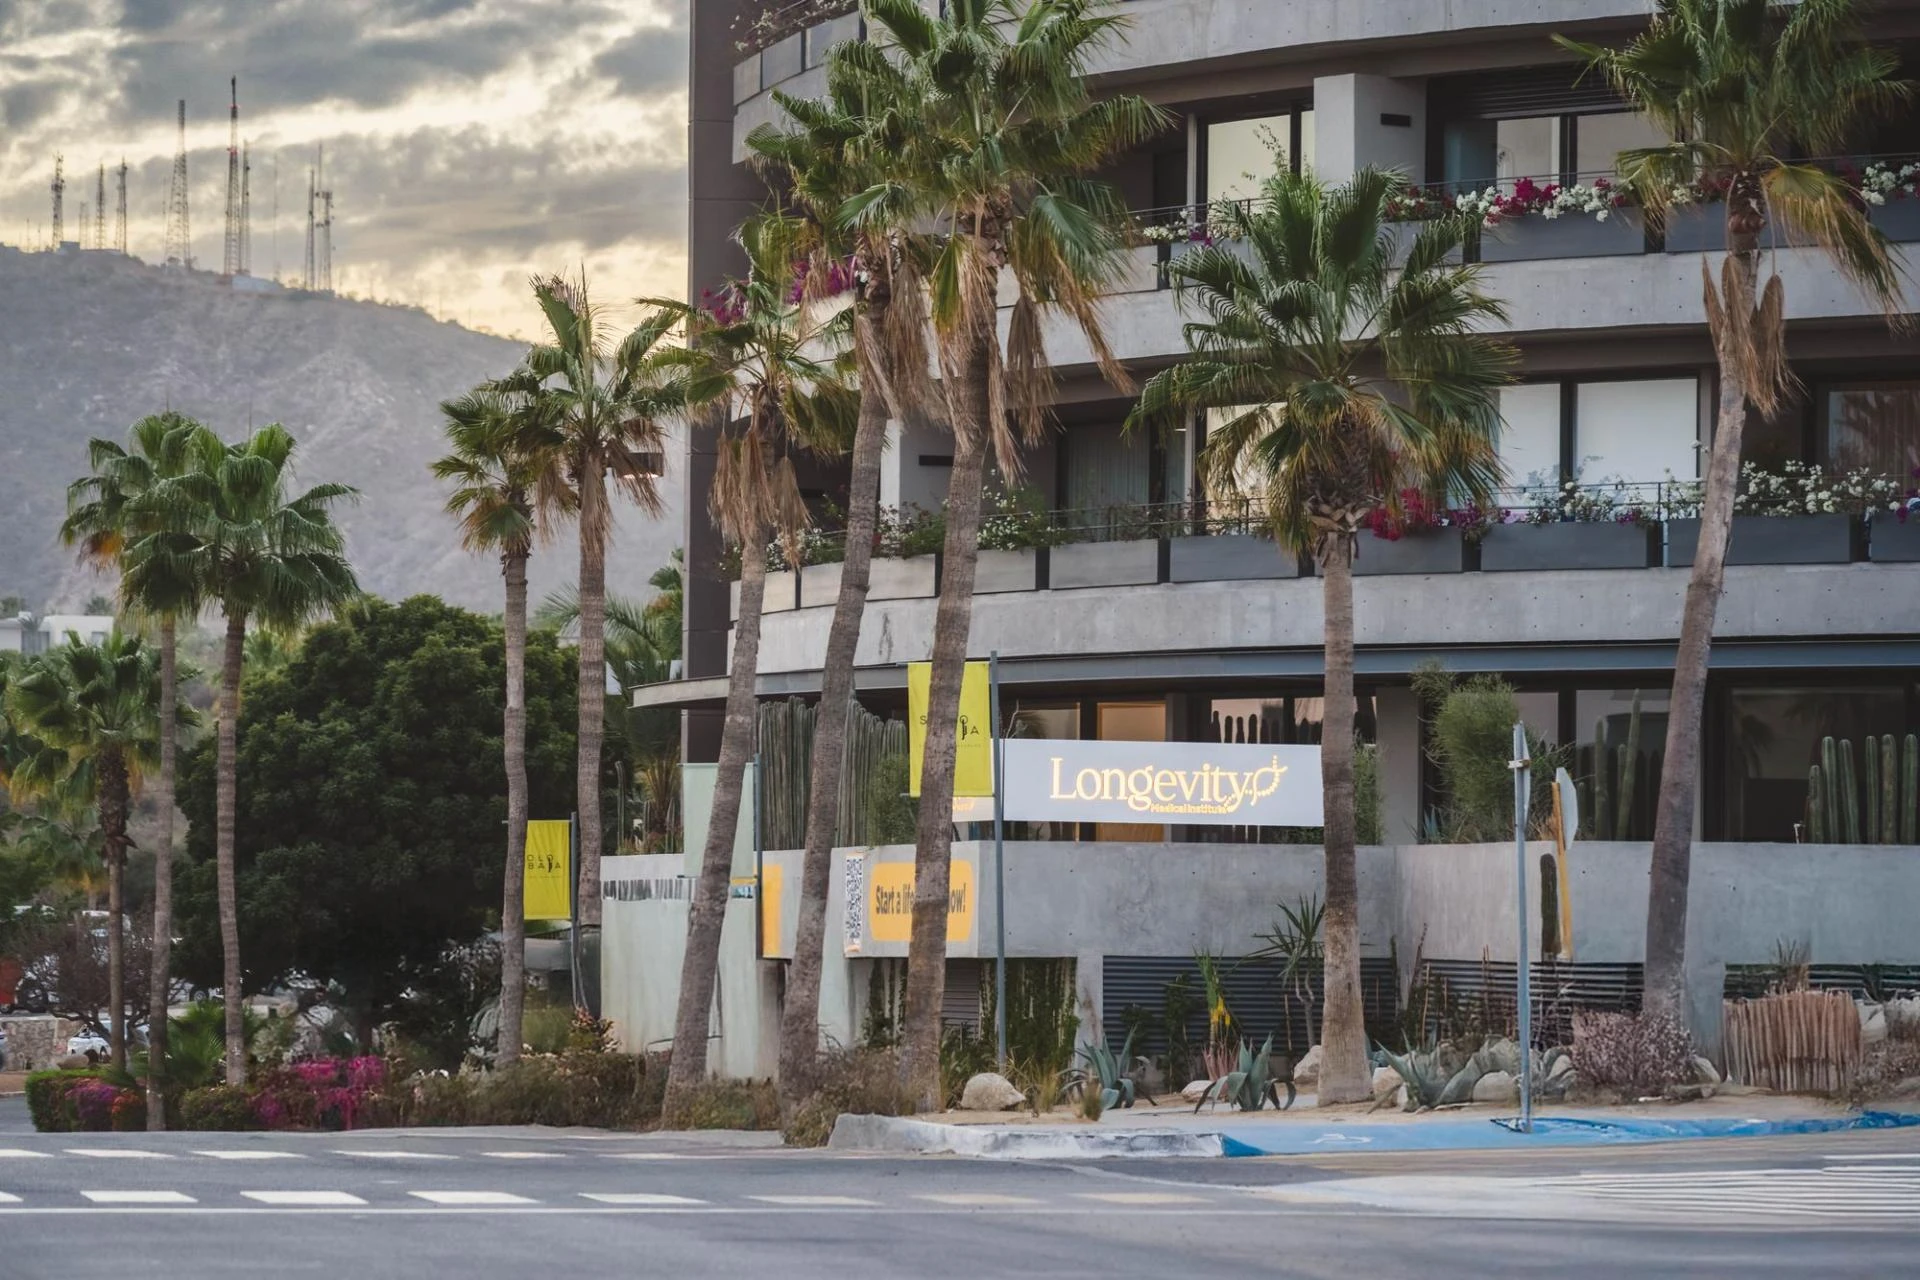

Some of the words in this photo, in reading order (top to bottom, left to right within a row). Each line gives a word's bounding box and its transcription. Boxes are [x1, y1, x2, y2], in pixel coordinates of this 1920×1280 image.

[1050, 757, 1253, 812] Longevity
[876, 885, 894, 914] Start
[896, 891, 901, 914] a
